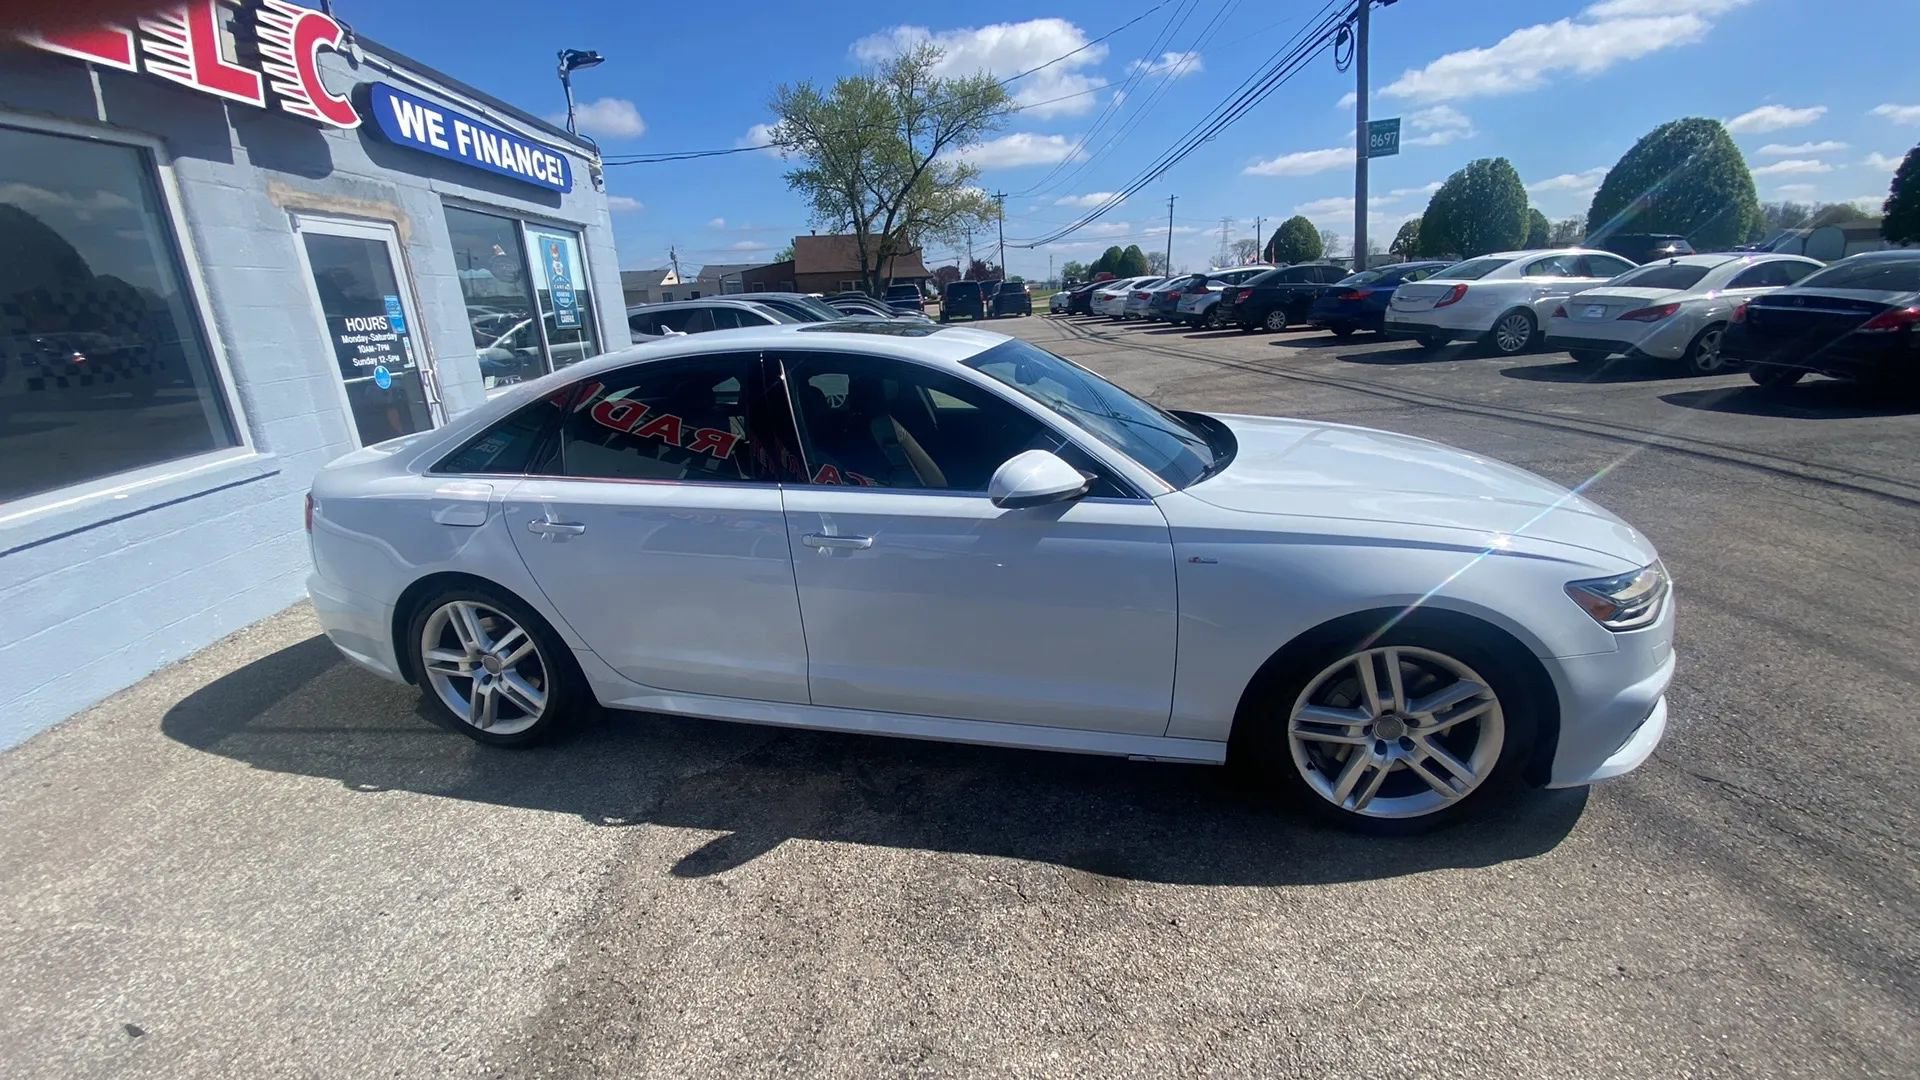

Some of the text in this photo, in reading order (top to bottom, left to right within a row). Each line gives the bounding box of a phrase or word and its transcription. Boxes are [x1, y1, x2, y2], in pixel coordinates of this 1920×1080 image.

[17, 0, 362, 129] LC
[389, 95, 565, 187] WE FINANCE!
[1371, 132, 1397, 148] 8697
[345, 317, 388, 332] HOURS
[342, 333, 397, 344] Monday-Saturday
[352, 357, 378, 367] Sunday
